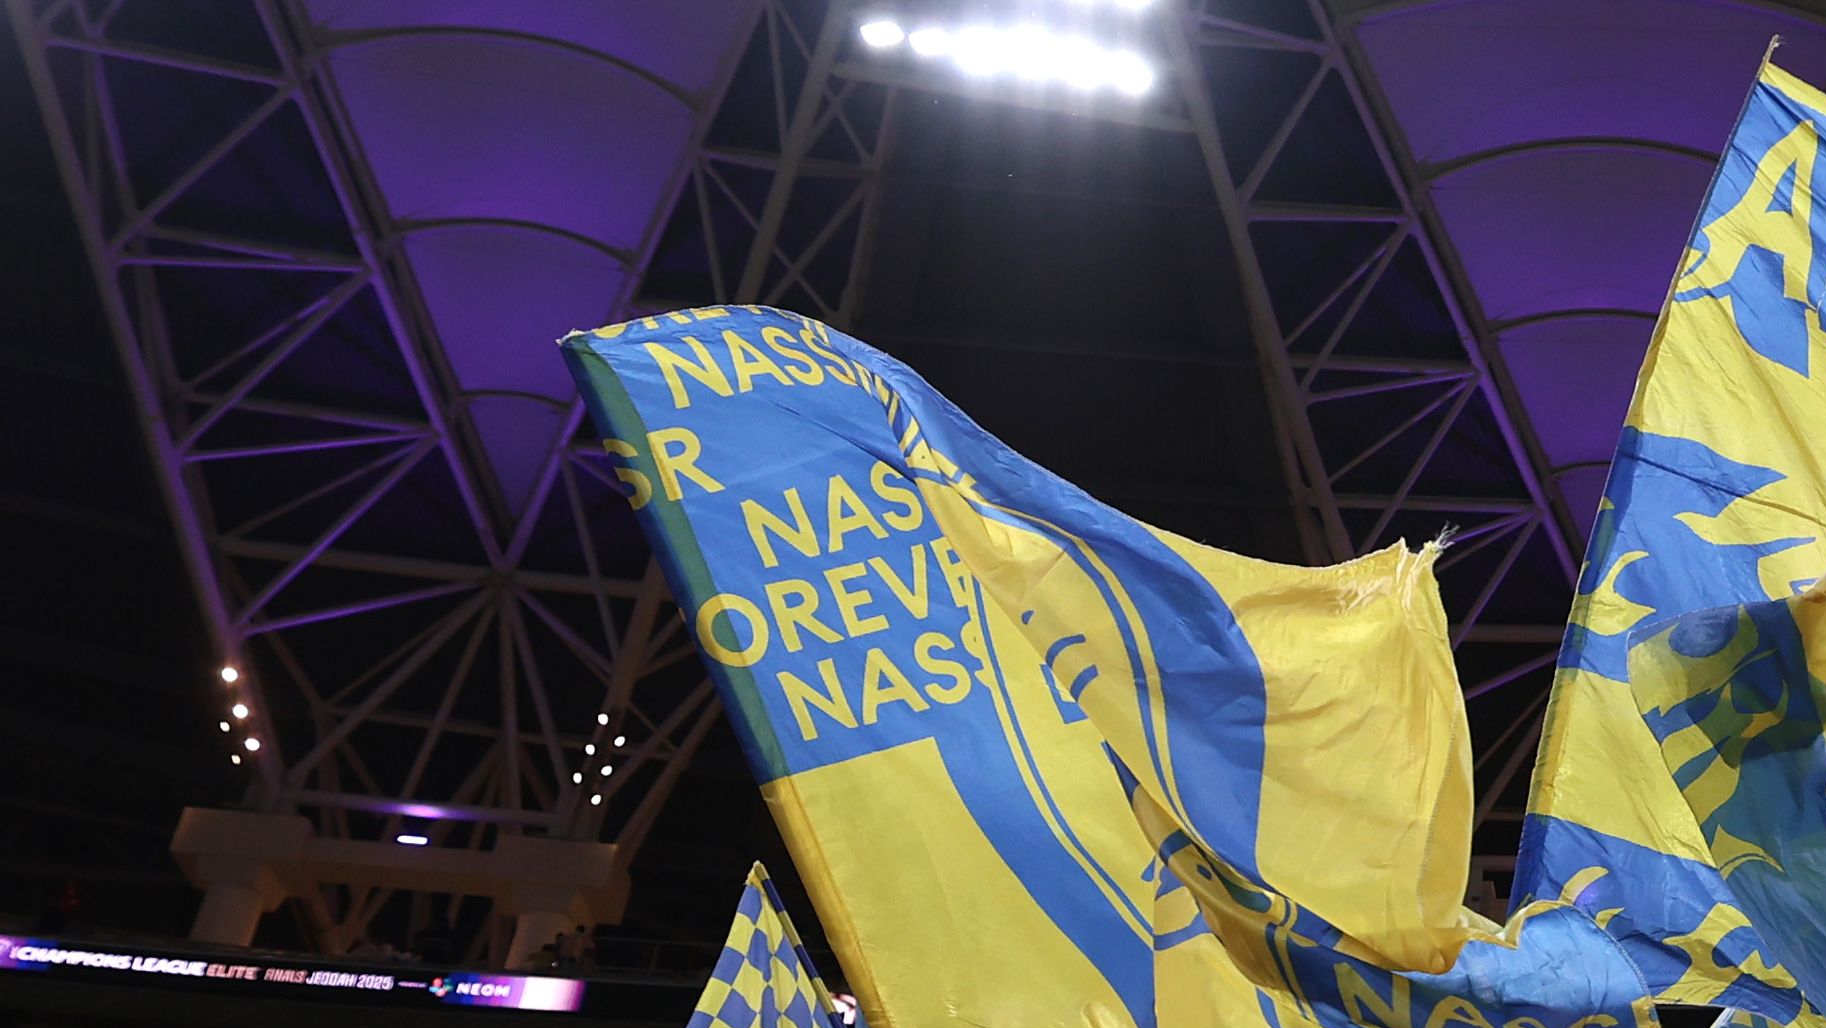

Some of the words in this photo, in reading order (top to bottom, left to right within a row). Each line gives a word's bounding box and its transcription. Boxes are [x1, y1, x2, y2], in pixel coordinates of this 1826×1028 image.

[17, 945, 132, 970] CHAMPIONS
[131, 955, 208, 977] LEAGUE
[206, 963, 262, 981] ELITE
[263, 967, 305, 984] FINALS
[305, 970, 356, 987] JEDDAH
[356, 974, 395, 991] 2025
[455, 981, 512, 998] NEOM
